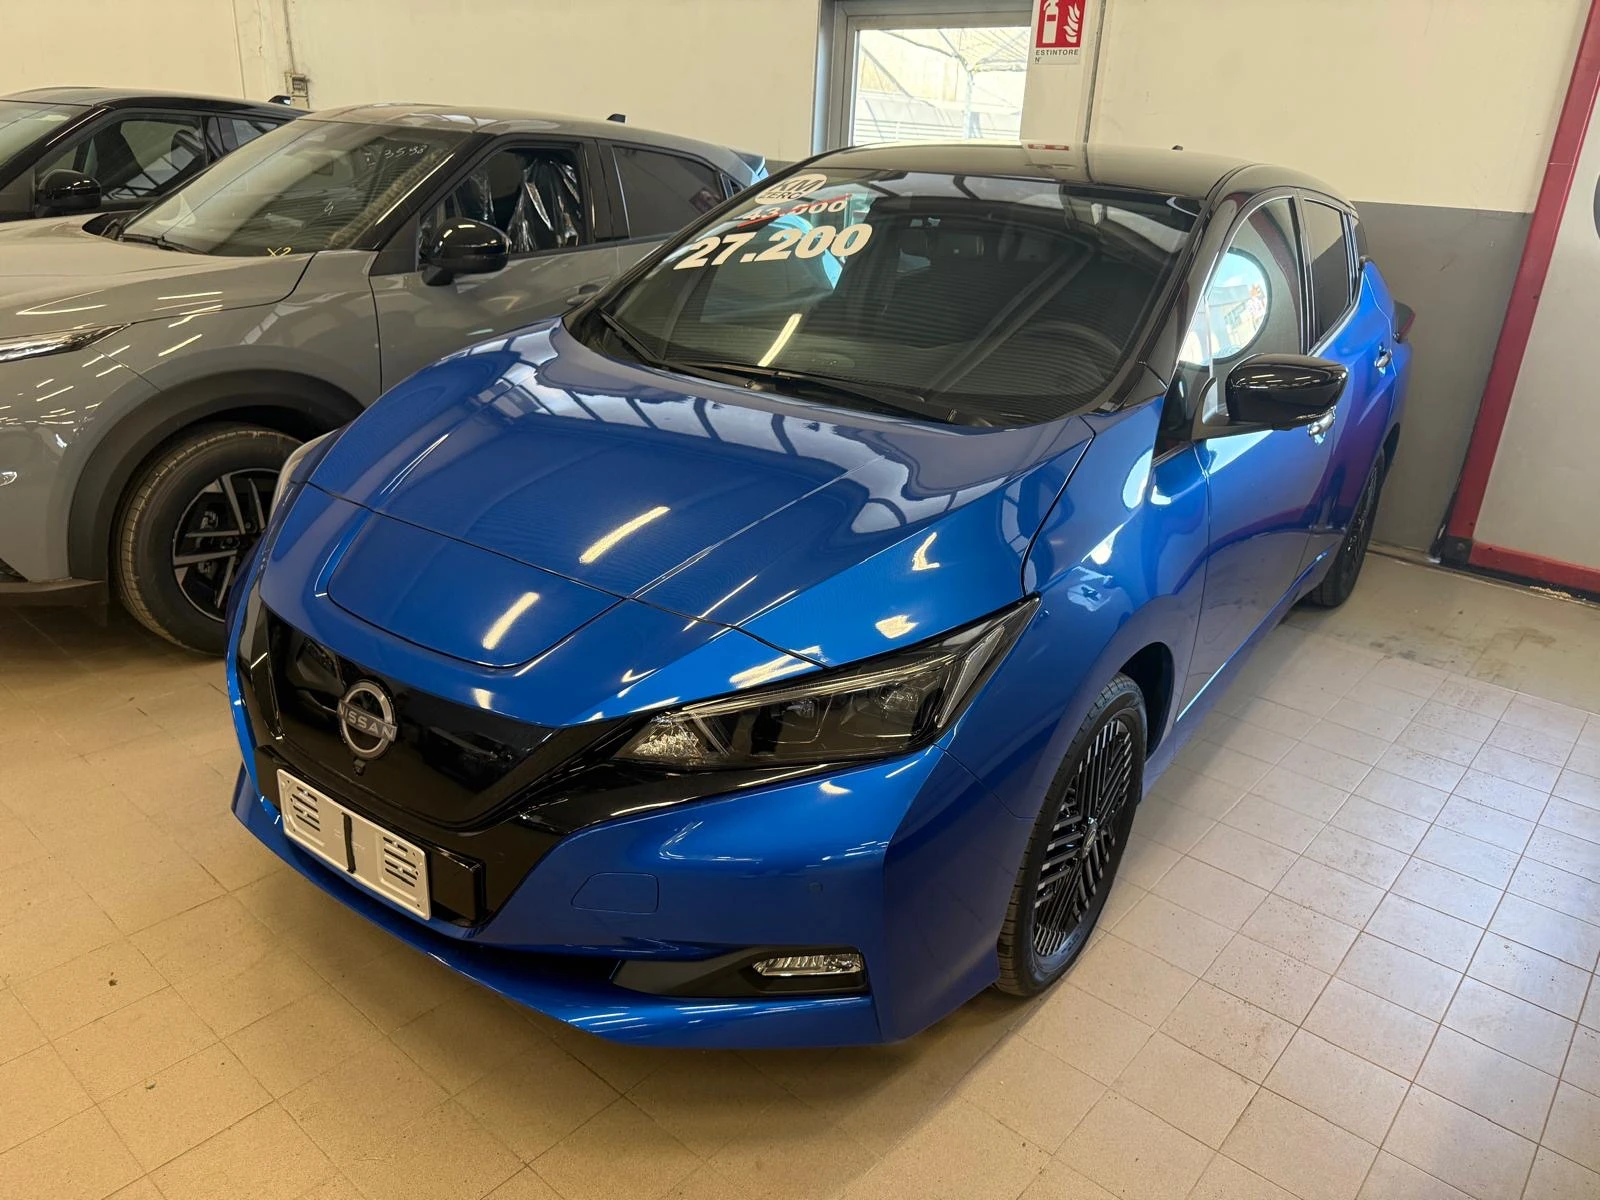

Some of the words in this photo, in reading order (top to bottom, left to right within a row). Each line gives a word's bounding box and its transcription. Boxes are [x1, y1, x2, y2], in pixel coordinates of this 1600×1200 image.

[758, 191, 804, 200] ZERO
[769, 179, 825, 192] KM
[673, 223, 873, 270] 27.200
[339, 702, 394, 739] NISSAN
